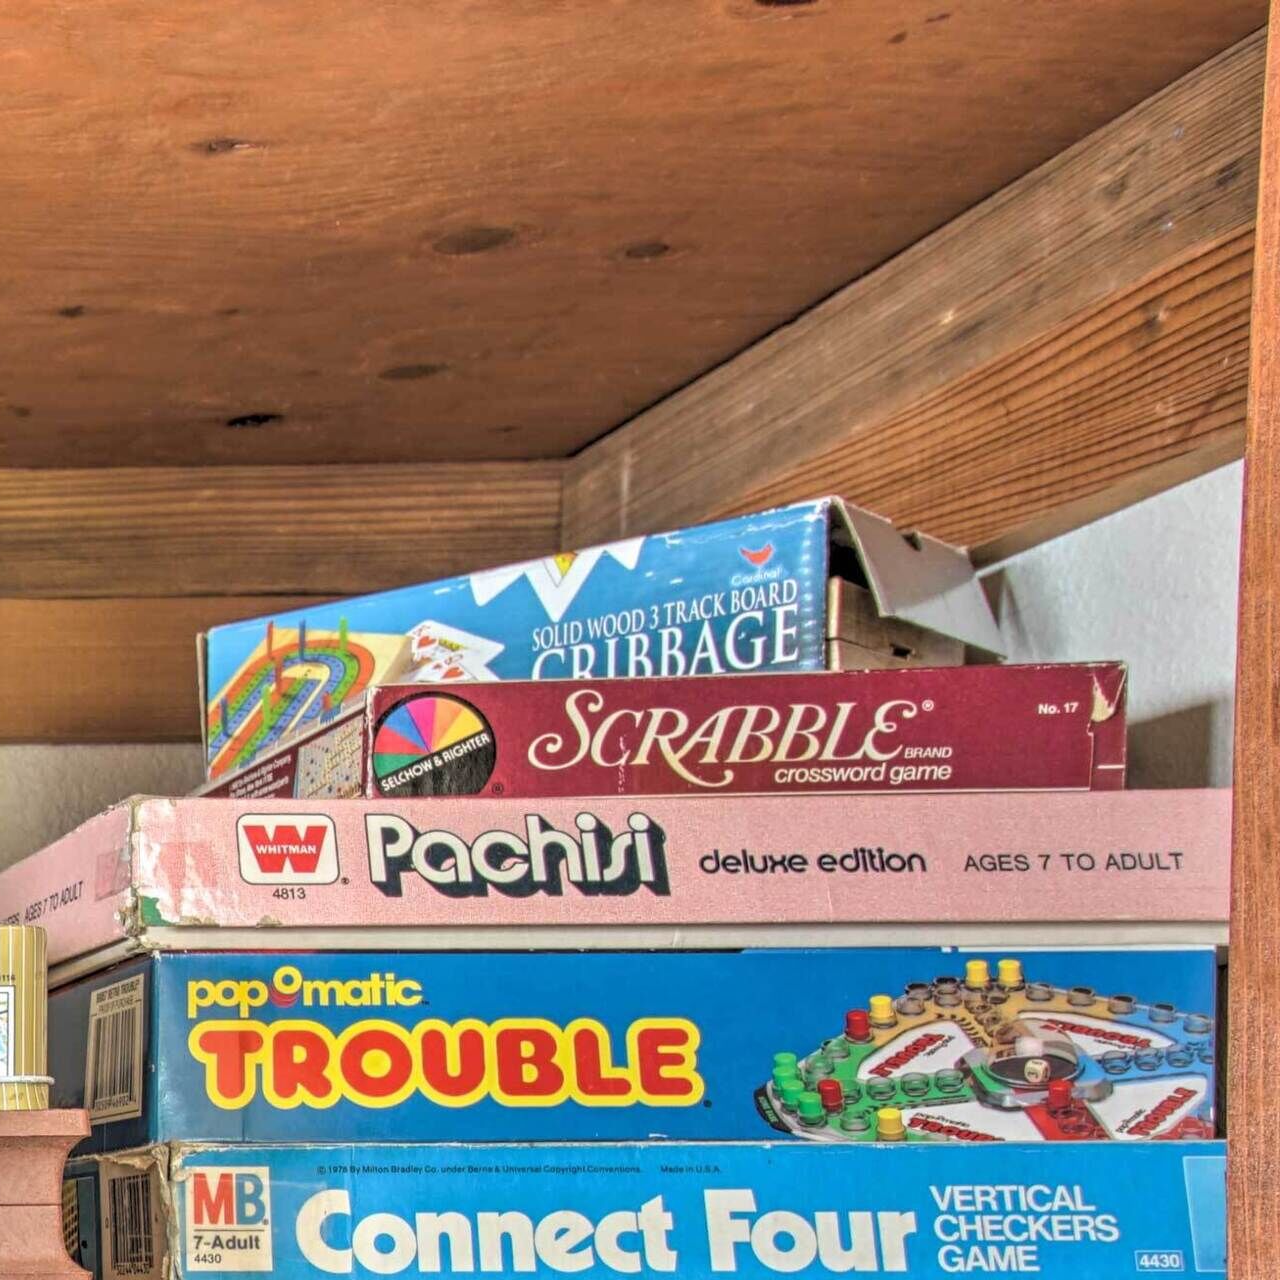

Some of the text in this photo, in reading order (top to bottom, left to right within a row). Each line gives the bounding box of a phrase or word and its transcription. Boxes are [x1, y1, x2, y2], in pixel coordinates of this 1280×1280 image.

[532, 579, 797, 650] SOLID WOOD 3 TRACK BOARD
[530, 602, 799, 680] CRIBBAGE
[1038, 702, 1077, 714] No. 17
[528, 689, 917, 788] SCRABBLE
[381, 733, 490, 791] SELCHOW & RIGHTER
[775, 764, 951, 783] crossword game
[256, 844, 316, 855] WHITMAN
[364, 812, 927, 897] Pachisi deluxe edition
[272, 888, 306, 899] 4813
[188, 1018, 705, 1109] TROUBLE
[192, 1172, 266, 1226] MB
[930, 1186, 1095, 1212] VERTICAL
[295, 1188, 916, 1274] Connect Four
[933, 1214, 1119, 1242] CHECKERS
[194, 1234, 260, 1250] 7-Adult
[194, 1253, 222, 1265] 4430
[939, 1245, 1040, 1272] GAME
[1139, 1253, 1180, 1268] 4430
